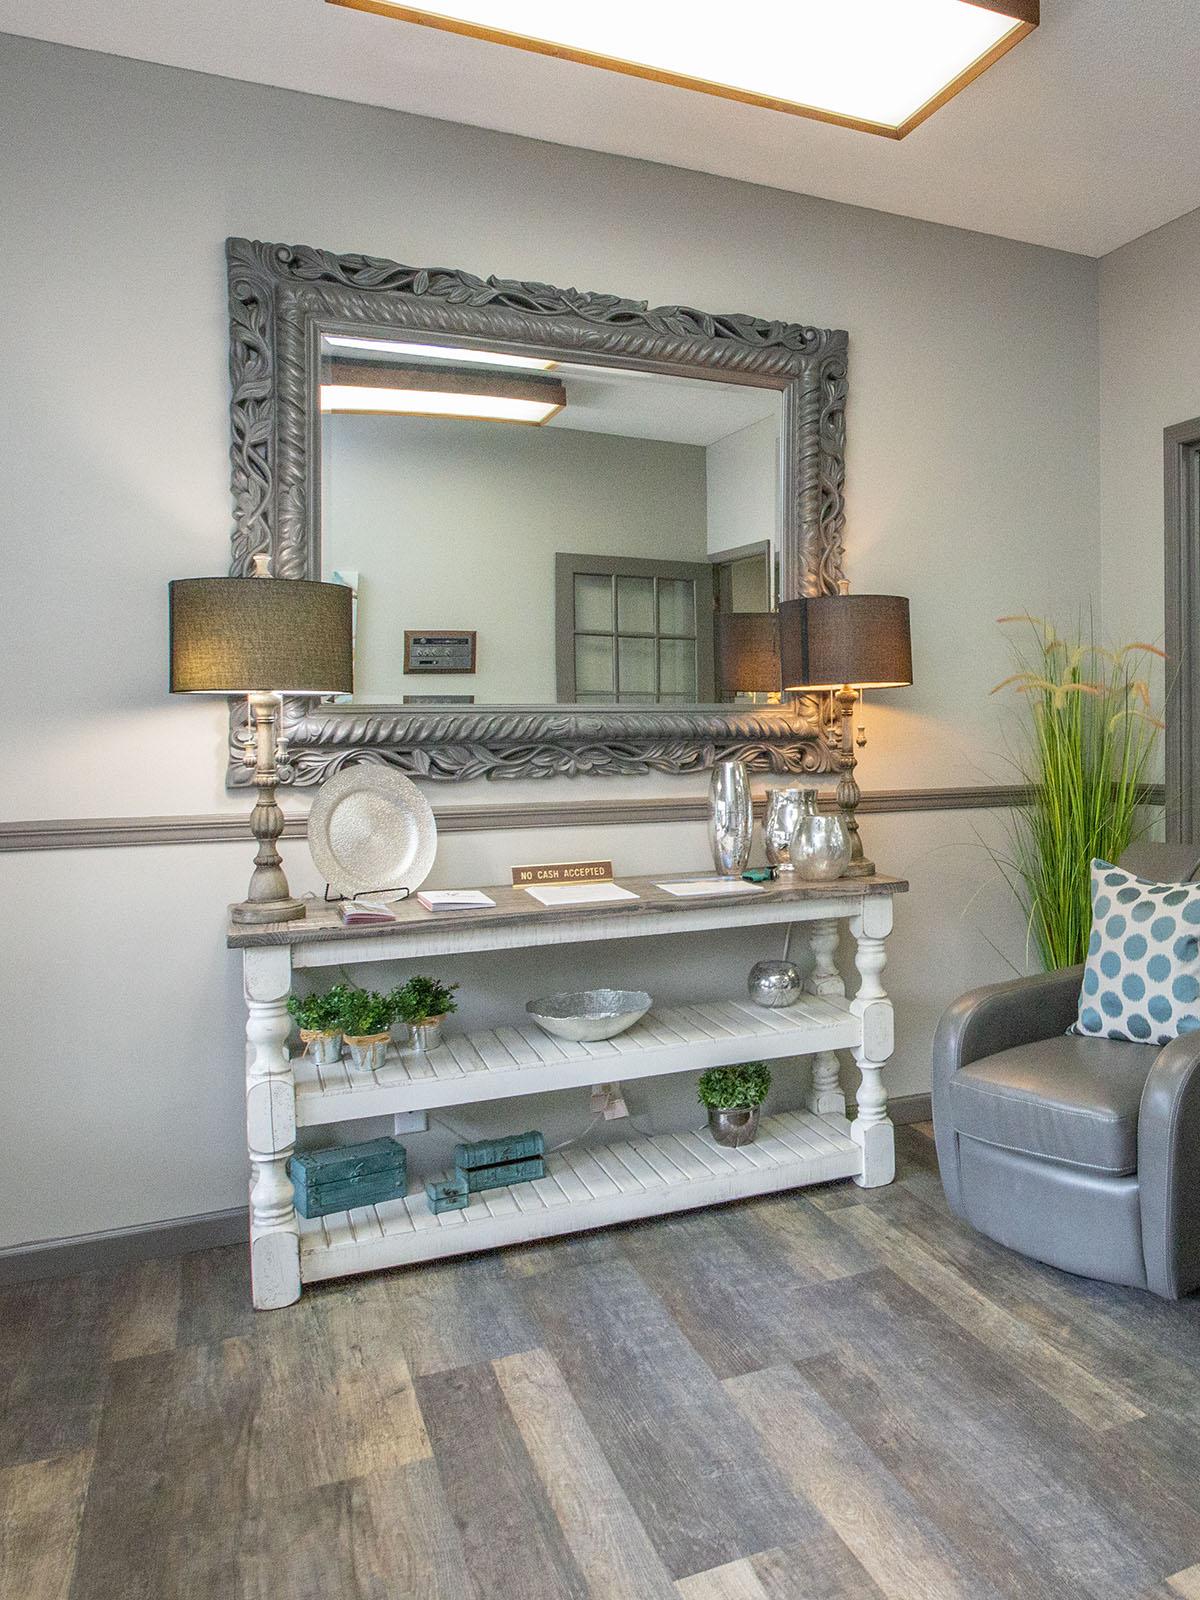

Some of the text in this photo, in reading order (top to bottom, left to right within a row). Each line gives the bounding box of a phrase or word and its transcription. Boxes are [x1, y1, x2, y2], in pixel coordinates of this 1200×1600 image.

[520, 867, 605, 880] NO CASH ACCEPTED
